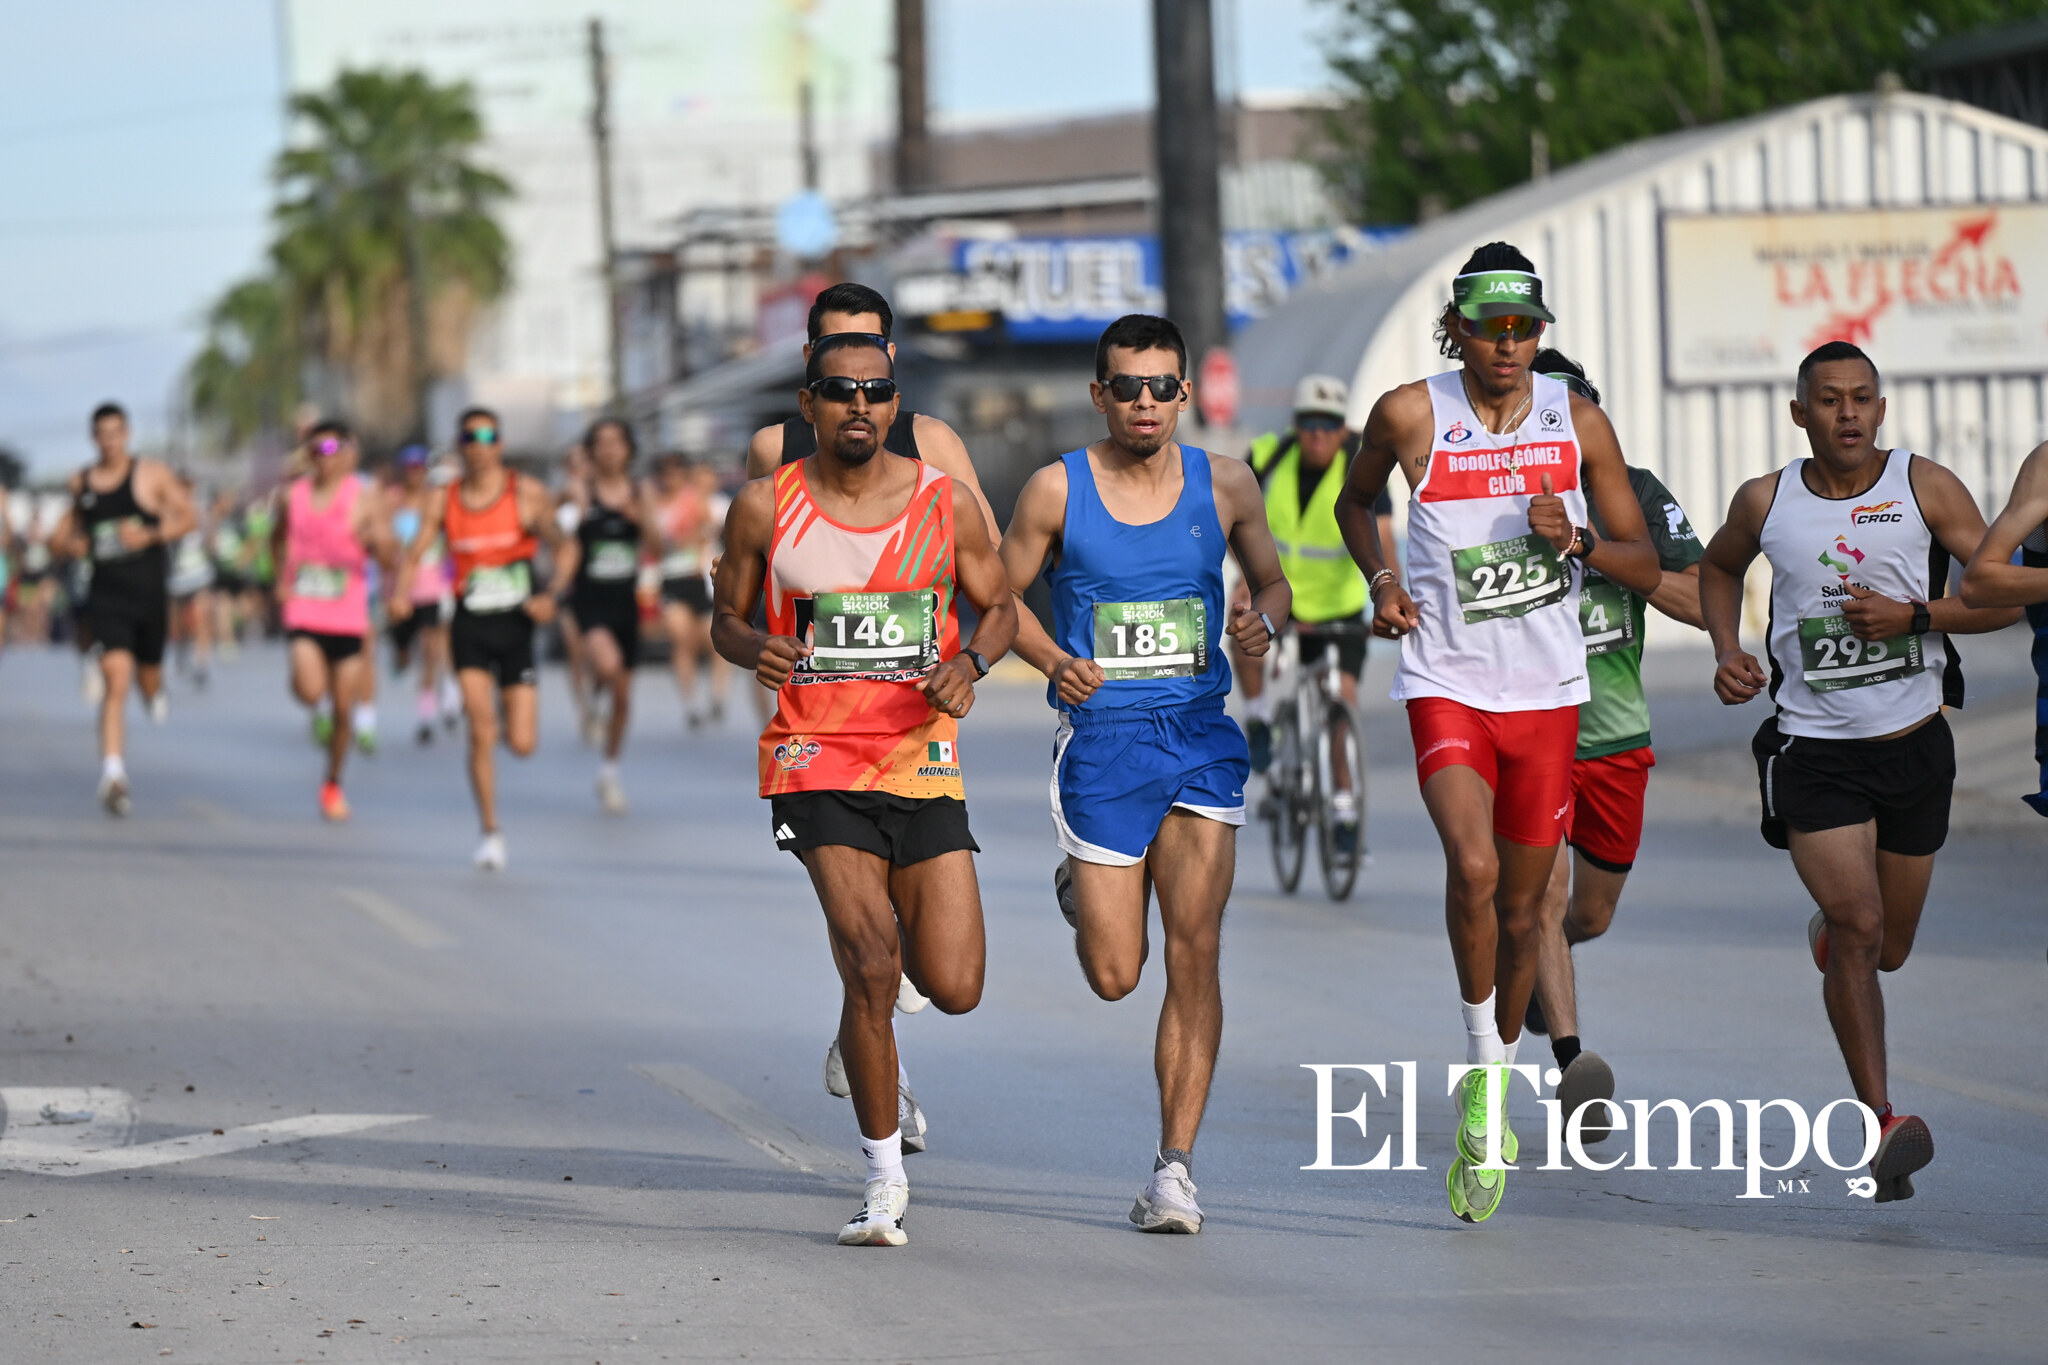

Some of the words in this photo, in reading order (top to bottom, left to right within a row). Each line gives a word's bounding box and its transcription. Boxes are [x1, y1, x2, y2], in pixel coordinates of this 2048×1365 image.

[1448, 452, 1512, 473] RODOLFO
[1513, 446, 1562, 468] GÓMEZ
[1488, 474, 1526, 496] CLUB
[1480, 536, 1528, 553] CARRERA
[1471, 553, 1548, 600] 225
[920, 593, 932, 602] 146
[1122, 603, 1165, 611] CARRERA
[1193, 603, 1204, 611] 185
[831, 614, 905, 647] 146
[922, 605, 931, 658] MEDALLA
[1622, 593, 1633, 639] MEDALLA
[1111, 622, 1179, 656] 185
[1196, 615, 1206, 666] MEDALLA
[1814, 635, 1888, 669] 295
